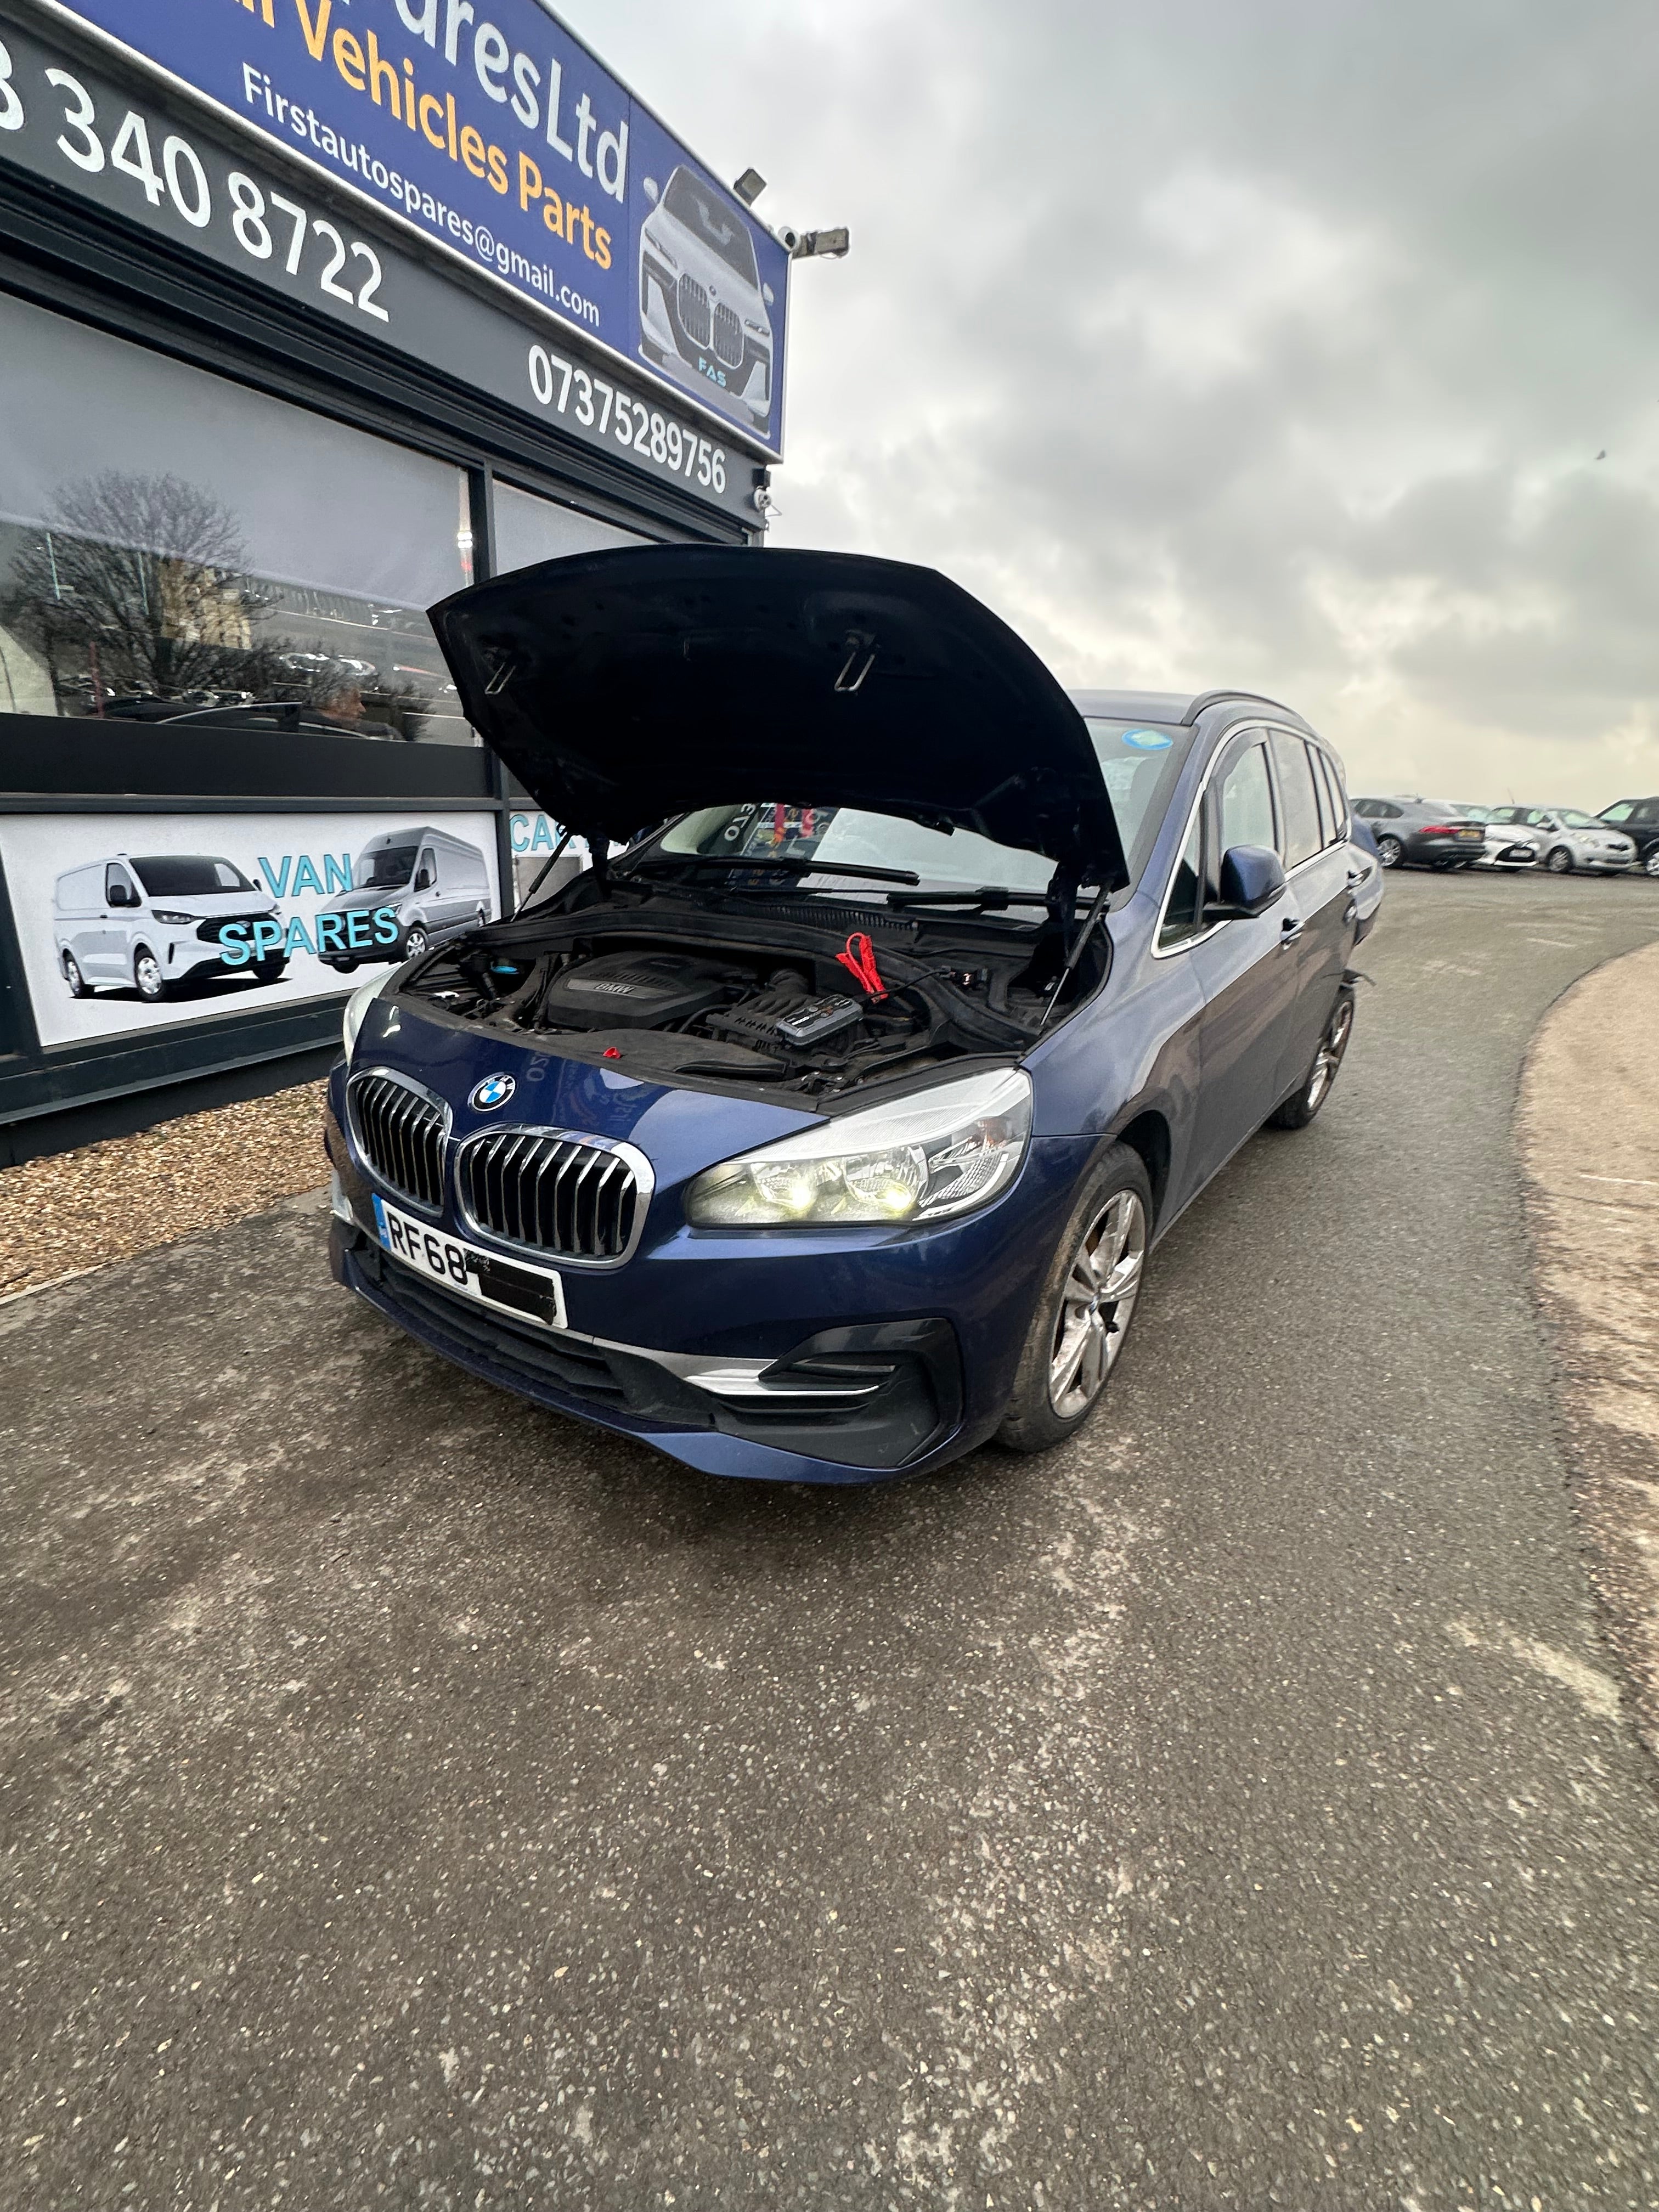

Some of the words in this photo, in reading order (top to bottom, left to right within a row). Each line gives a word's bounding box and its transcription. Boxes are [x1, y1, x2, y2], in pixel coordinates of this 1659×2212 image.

[45, 68, 211, 228] 340
[228, 172, 389, 323] 8722
[242, 61, 599, 327] Firstautospares@gmail.com
[296, 0, 509, 194] Vehicles
[519, 151, 611, 269] Parts
[529, 345, 726, 493] 07375289756
[698, 356, 726, 387] FAS
[219, 907, 399, 967] SPARES
[258, 853, 353, 899] VAN
